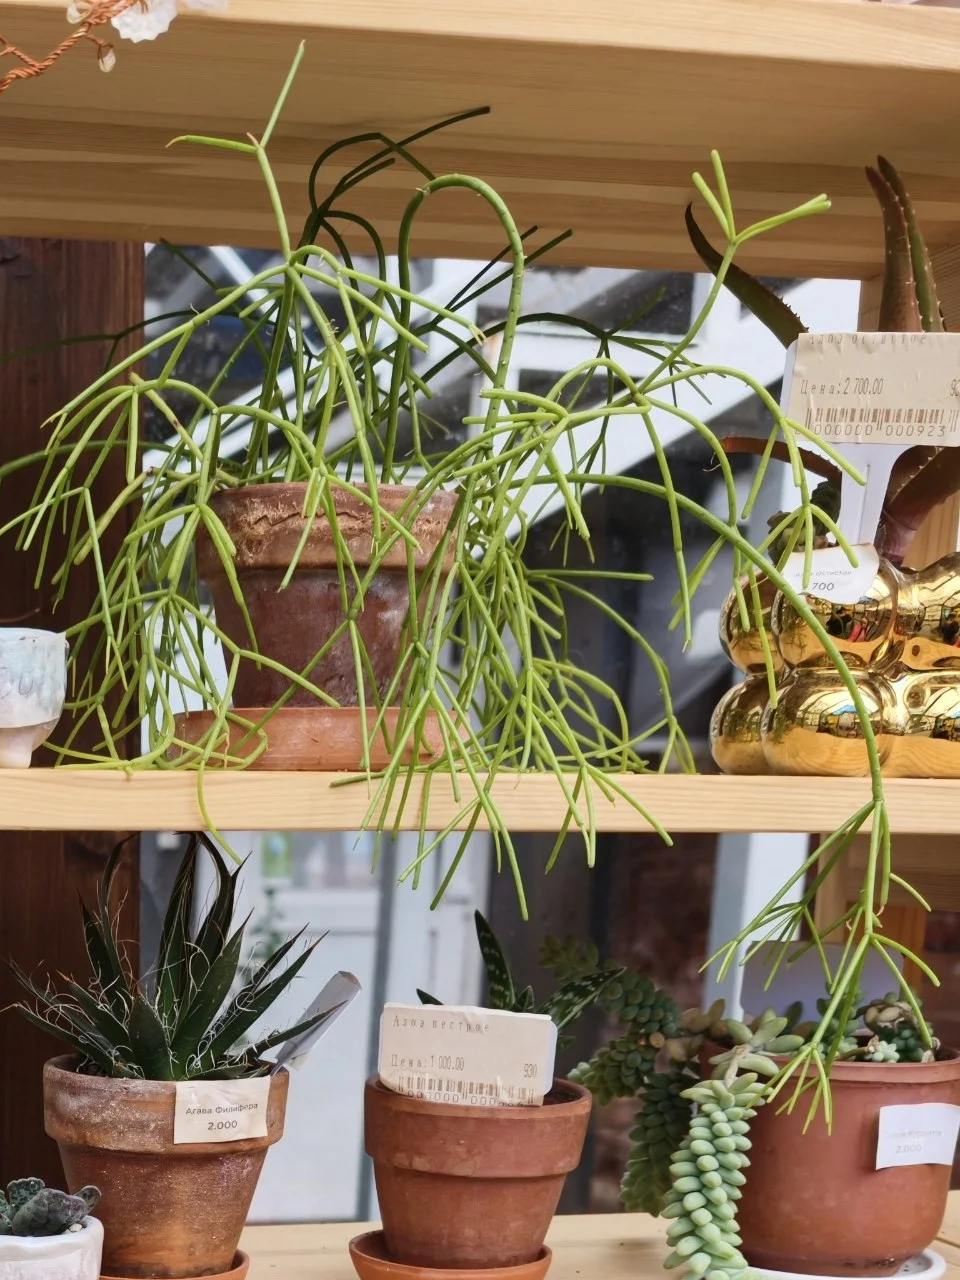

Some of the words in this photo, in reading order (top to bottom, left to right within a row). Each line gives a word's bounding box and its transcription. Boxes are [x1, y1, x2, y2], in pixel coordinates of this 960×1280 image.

[885, 425, 946, 437] 000923
[392, 1015, 425, 1028] Алоэ
[432, 1019, 489, 1033] пестрое
[523, 1063, 538, 1078] 930
[185, 1107, 213, 1115] Агава
[215, 1102, 258, 1113] Филифера
[207, 1120, 238, 1131] 2.000
